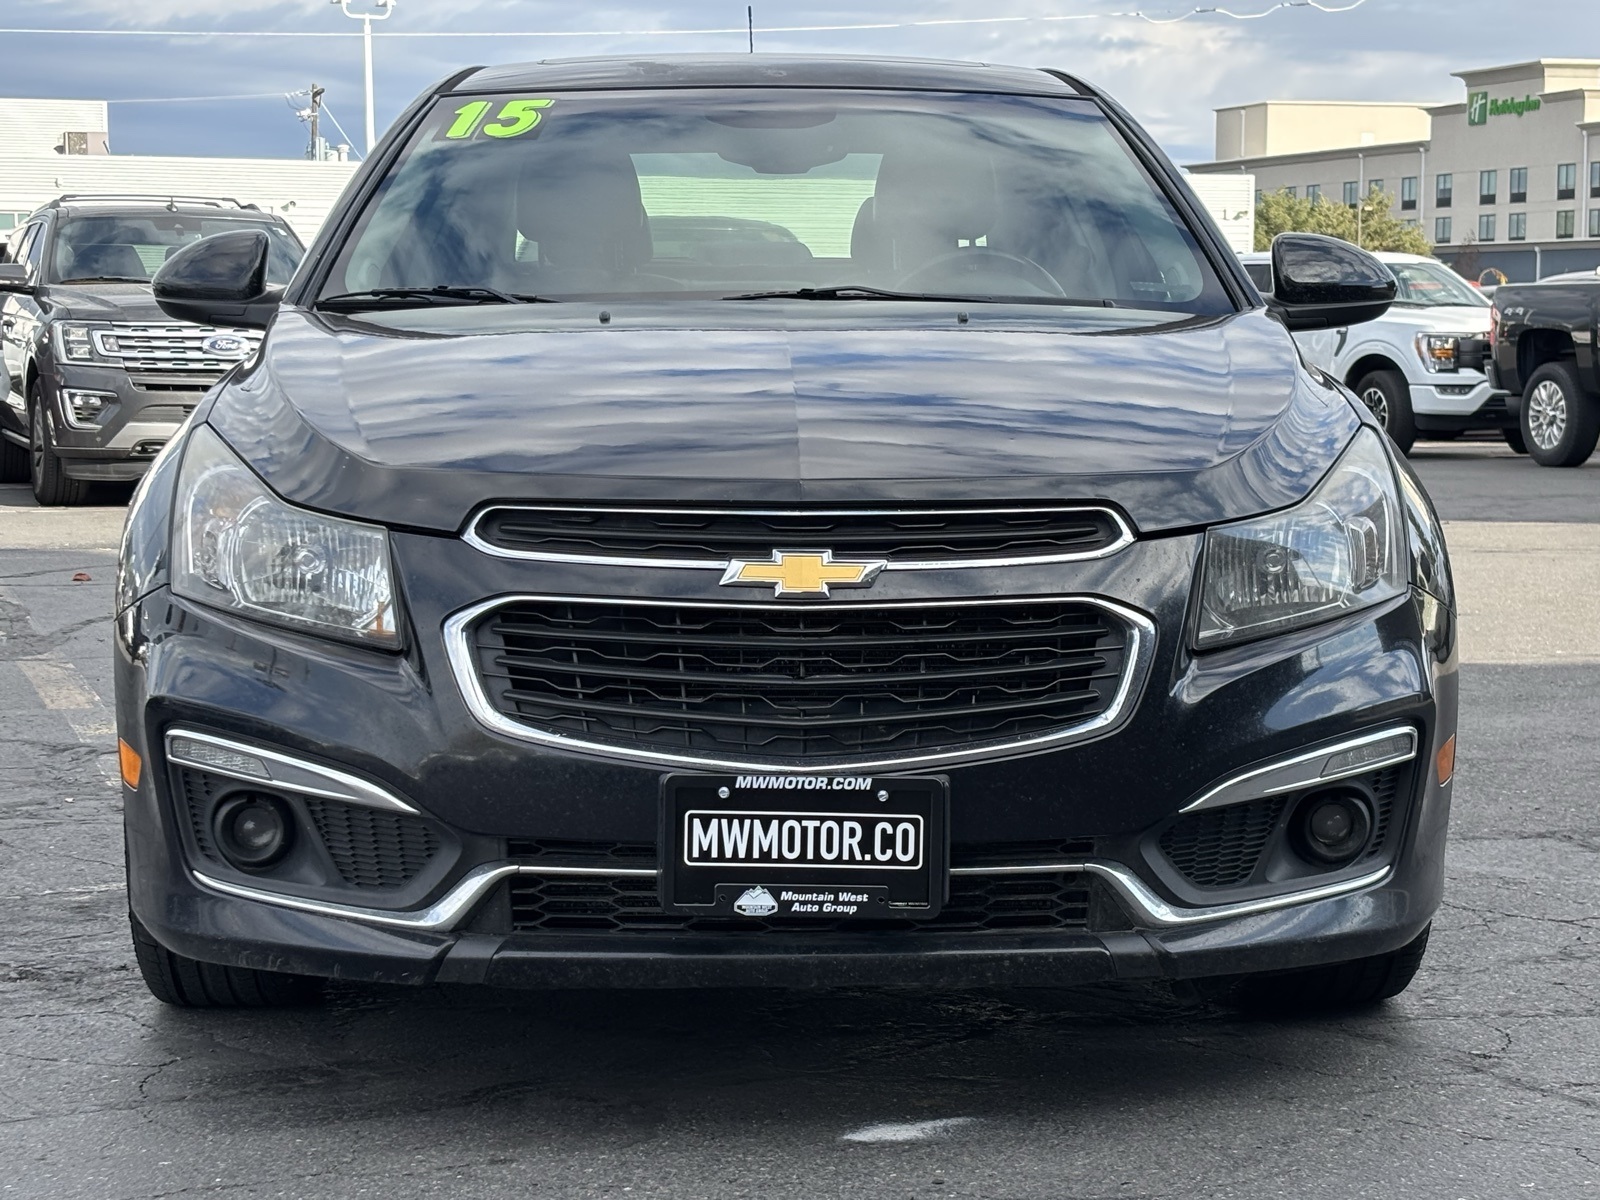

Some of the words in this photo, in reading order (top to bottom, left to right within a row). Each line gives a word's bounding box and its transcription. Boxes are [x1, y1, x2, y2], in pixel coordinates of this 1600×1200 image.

[446, 99, 555, 138] 15
[735, 776, 872, 790] MWMOTOR.COM
[692, 818, 915, 862] MWMOTOR.CO
[780, 891, 835, 902] Mountain
[839, 892, 869, 902] West
[791, 903, 819, 912] Auto
[822, 903, 858, 914] Group
